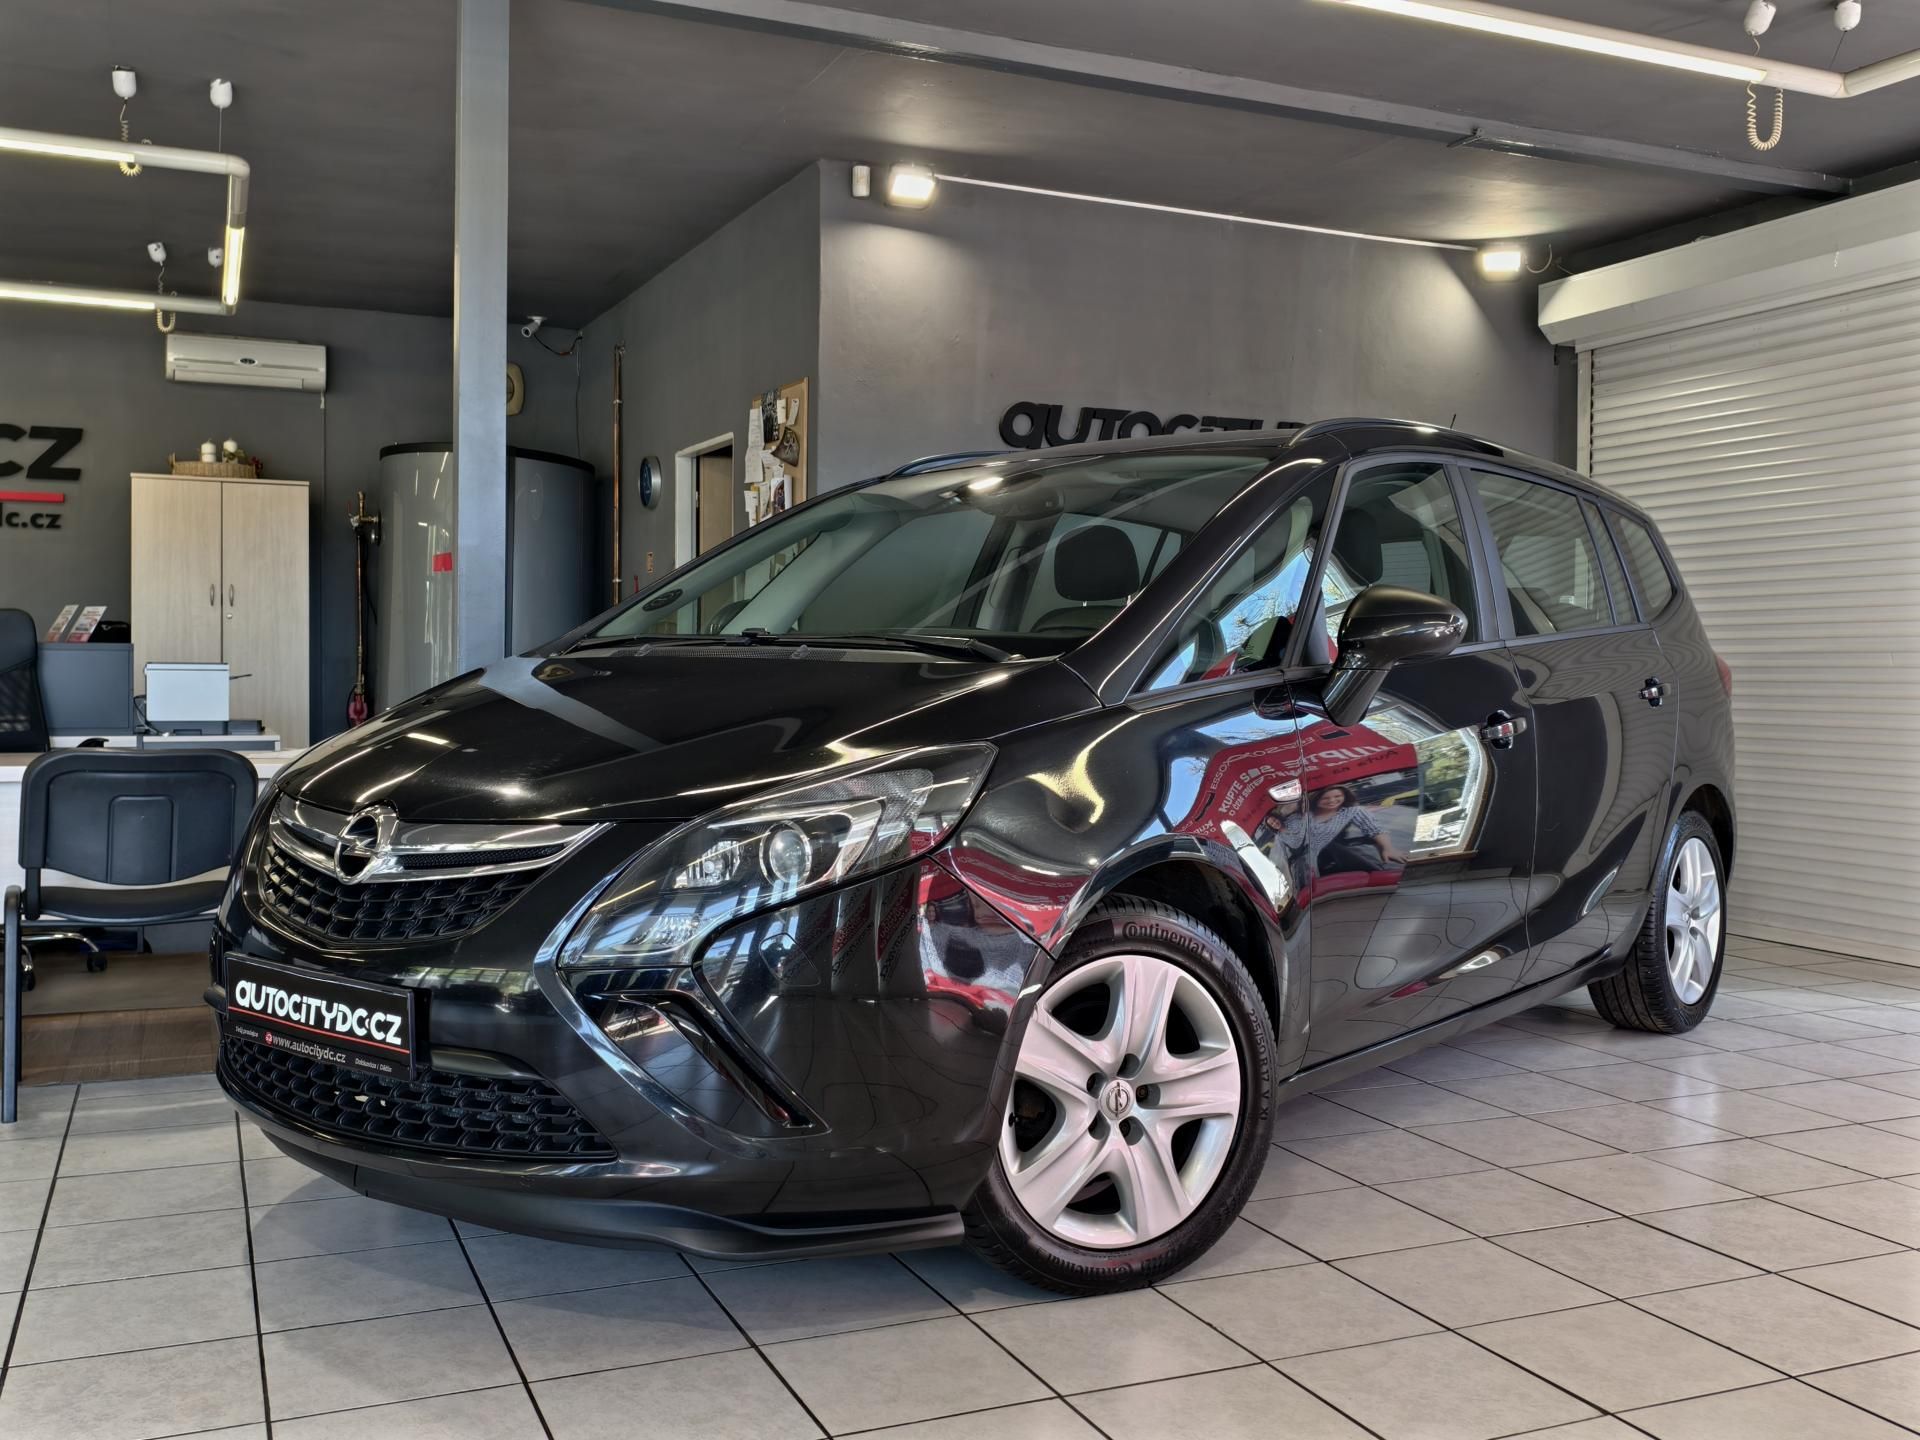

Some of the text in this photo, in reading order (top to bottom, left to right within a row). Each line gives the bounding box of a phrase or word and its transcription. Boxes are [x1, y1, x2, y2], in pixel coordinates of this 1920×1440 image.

[0, 503, 61, 529] c.cz
[1122, 921, 1204, 955] Continental
[1247, 1008, 1267, 1054] 225/50
[272, 1034, 346, 1063] www.autocitydc.cz
